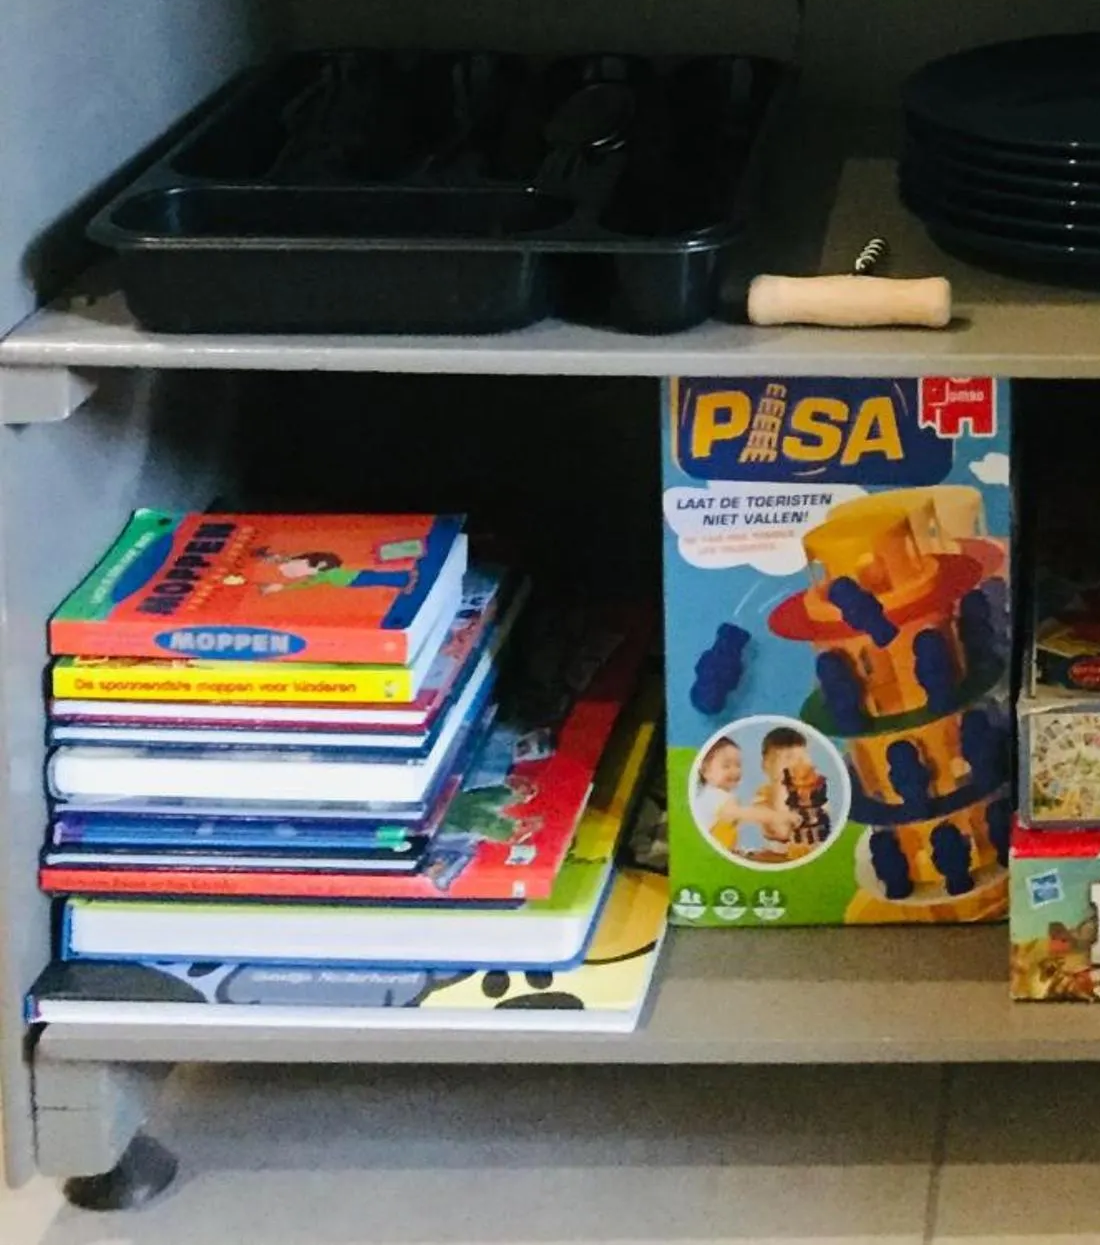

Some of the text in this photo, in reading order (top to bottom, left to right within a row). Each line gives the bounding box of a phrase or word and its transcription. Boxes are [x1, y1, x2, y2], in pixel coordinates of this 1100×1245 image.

[691, 382, 905, 466] PISA
[676, 492, 833, 511] LAAT DE TOERISTEN
[702, 510, 809, 526] NIET VALLEN!
[170, 632, 289, 653] MOPPEN
[74, 678, 95, 692] De
[258, 682, 288, 693] voor
[293, 677, 357, 694] kinderen
